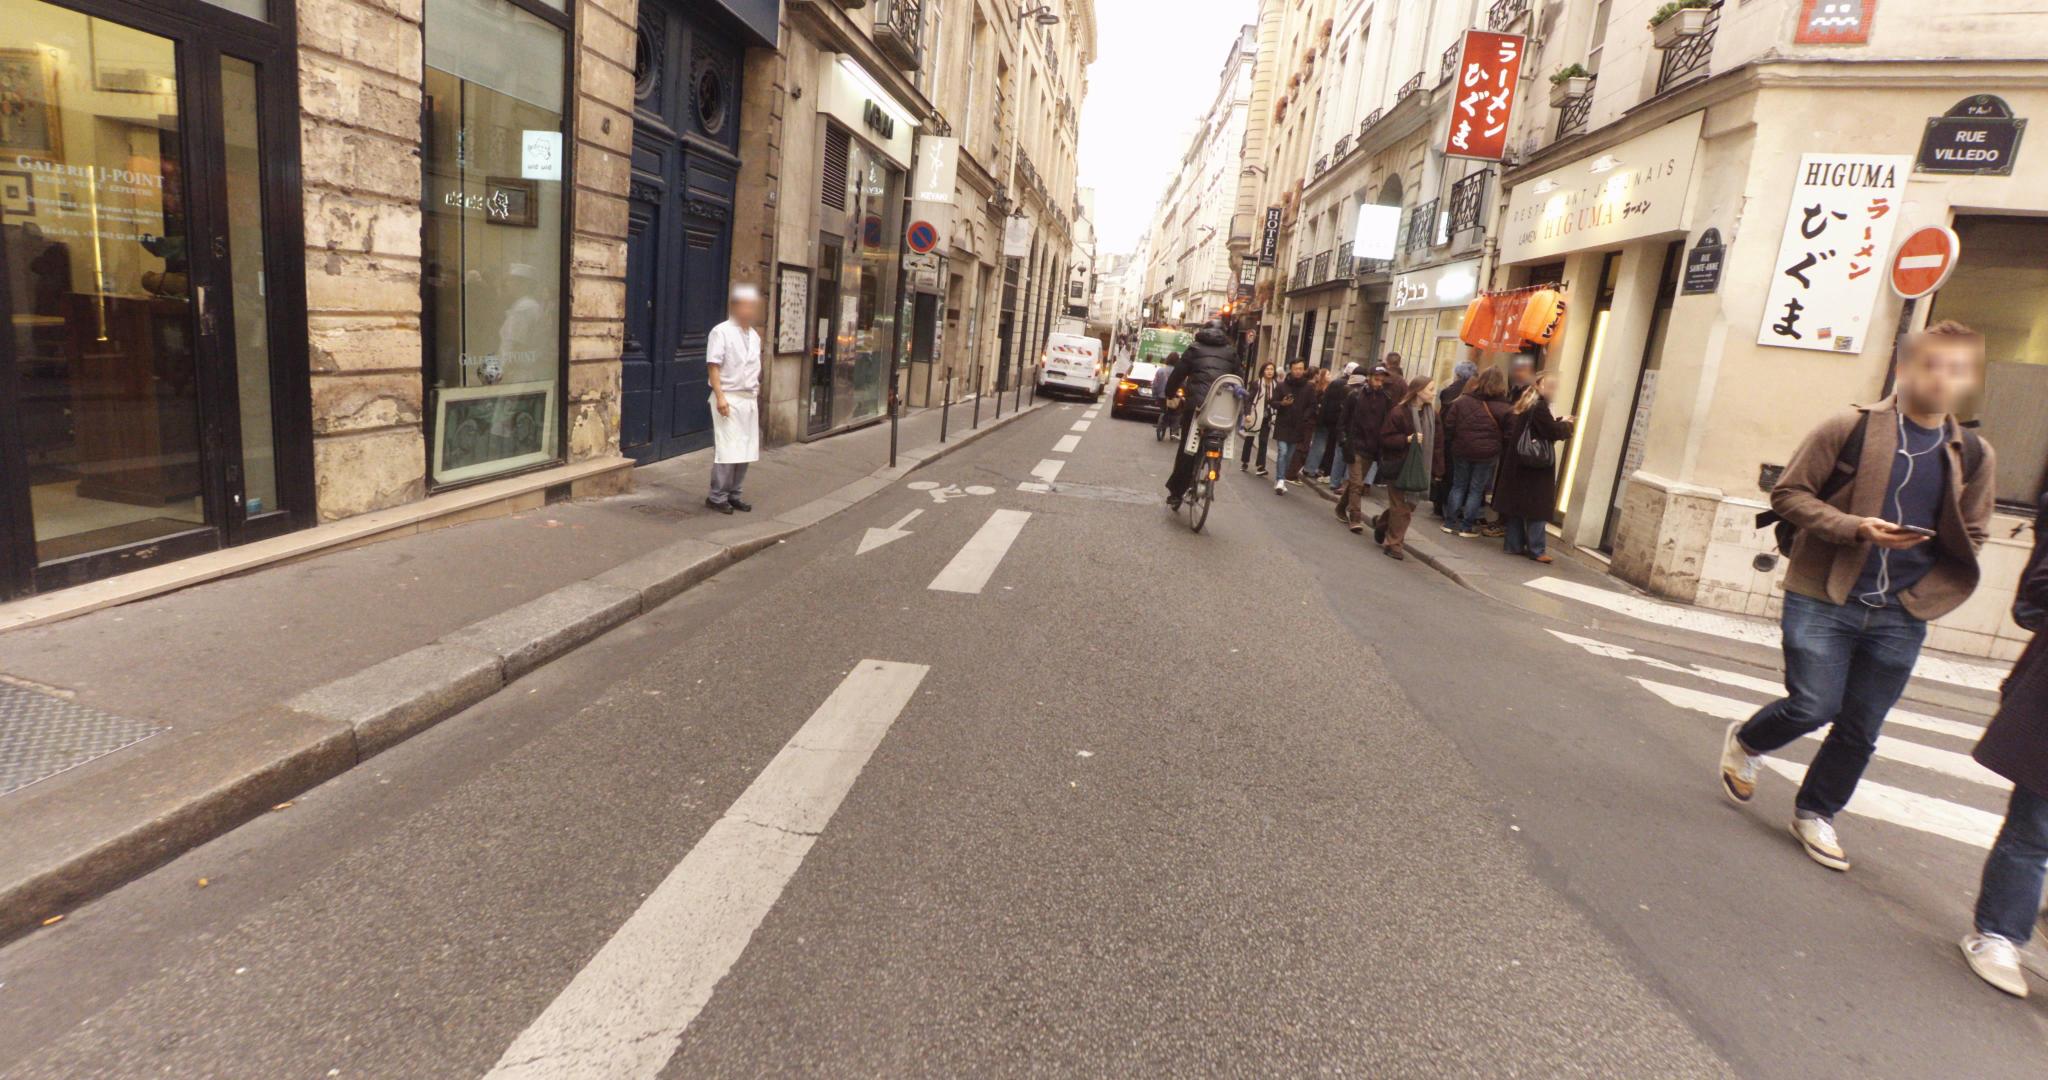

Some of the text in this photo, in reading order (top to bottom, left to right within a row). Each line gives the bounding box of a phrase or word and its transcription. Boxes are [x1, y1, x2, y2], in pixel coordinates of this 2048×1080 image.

[1452, 63, 1489, 150] ひぐま
[1484, 42, 1517, 138] ラーメン
[1935, 148, 1999, 161] VILLEDO
[1955, 130, 1987, 143] RUE
[100, 166, 165, 189] J-POINT
[1803, 162, 1896, 189] HIGUMA
[1264, 209, 1279, 257] HOTEL
[1848, 198, 1890, 280] ラーメン
[1772, 203, 1848, 340] ひぐま
